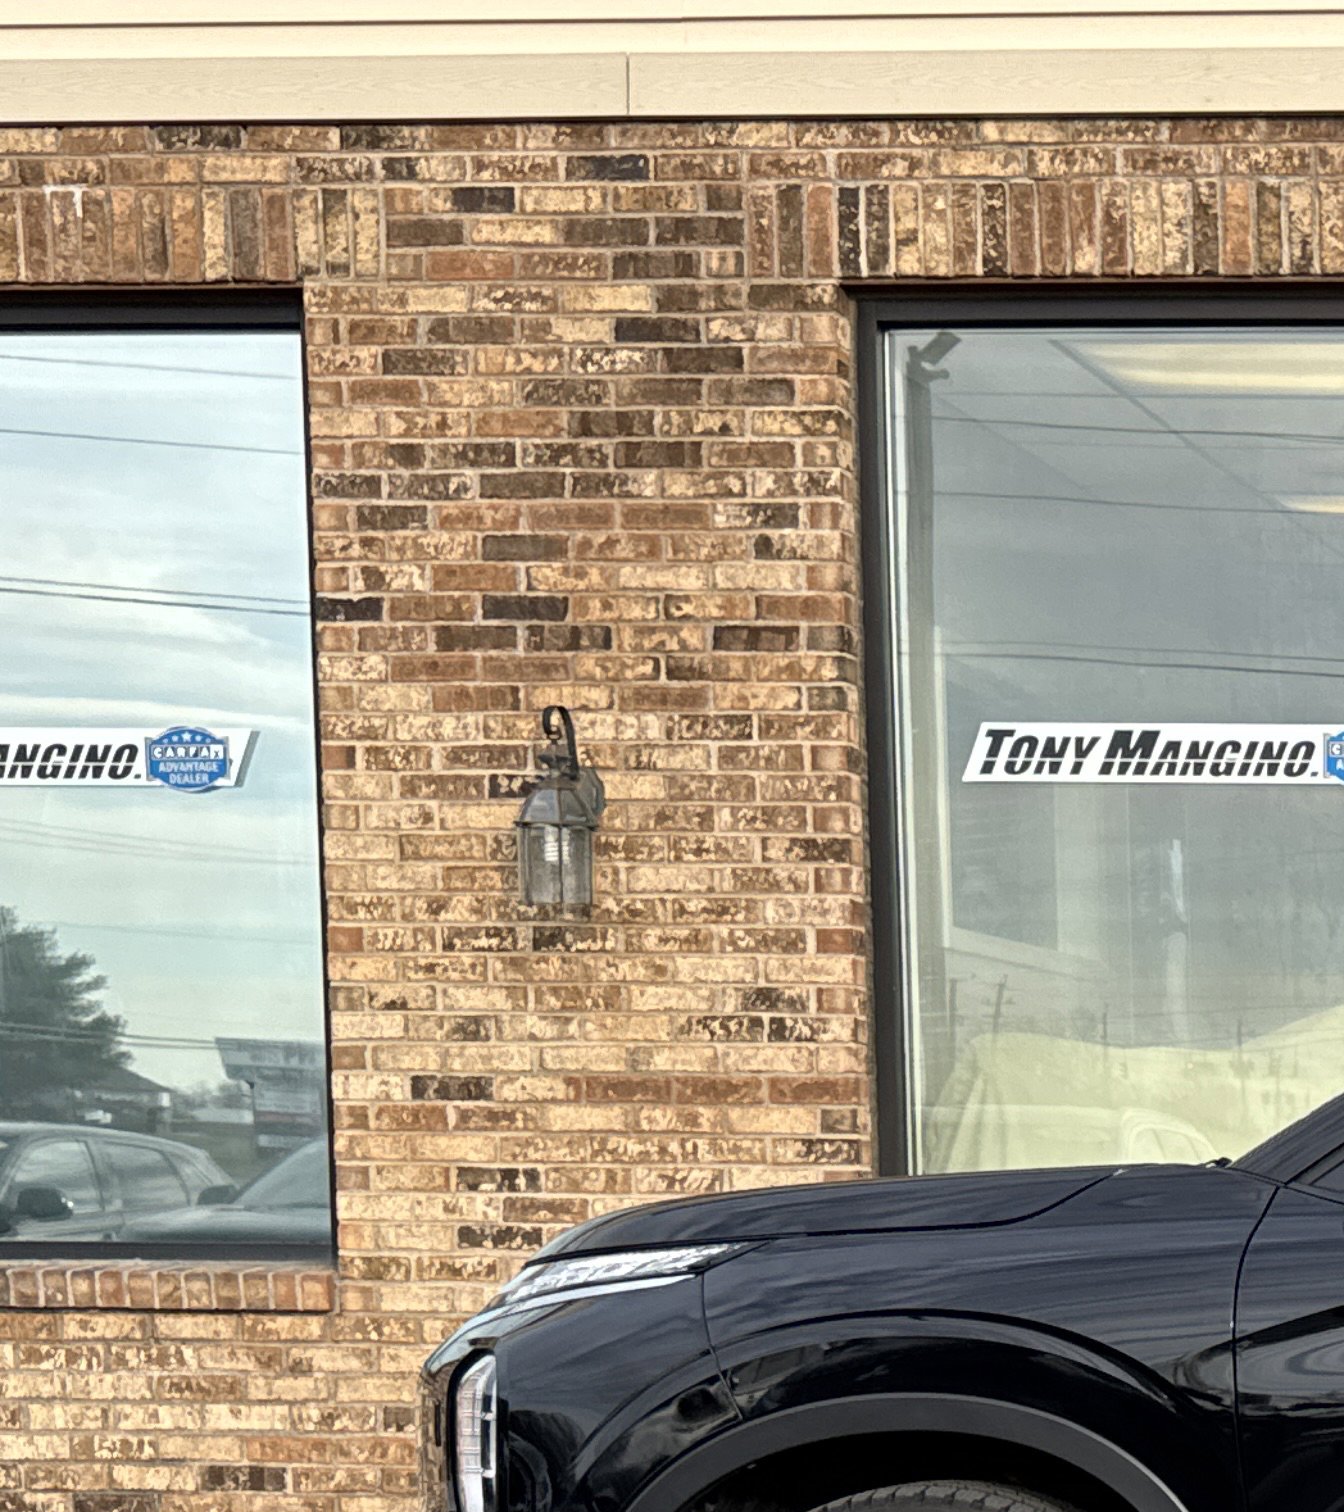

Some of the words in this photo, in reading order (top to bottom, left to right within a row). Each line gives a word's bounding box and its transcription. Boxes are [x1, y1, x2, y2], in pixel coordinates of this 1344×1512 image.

[152, 744, 223, 760] CARFAX
[978, 729, 1102, 776] TONY
[159, 761, 219, 773] ADVANTAGE
[168, 772, 210, 785] DEALER
